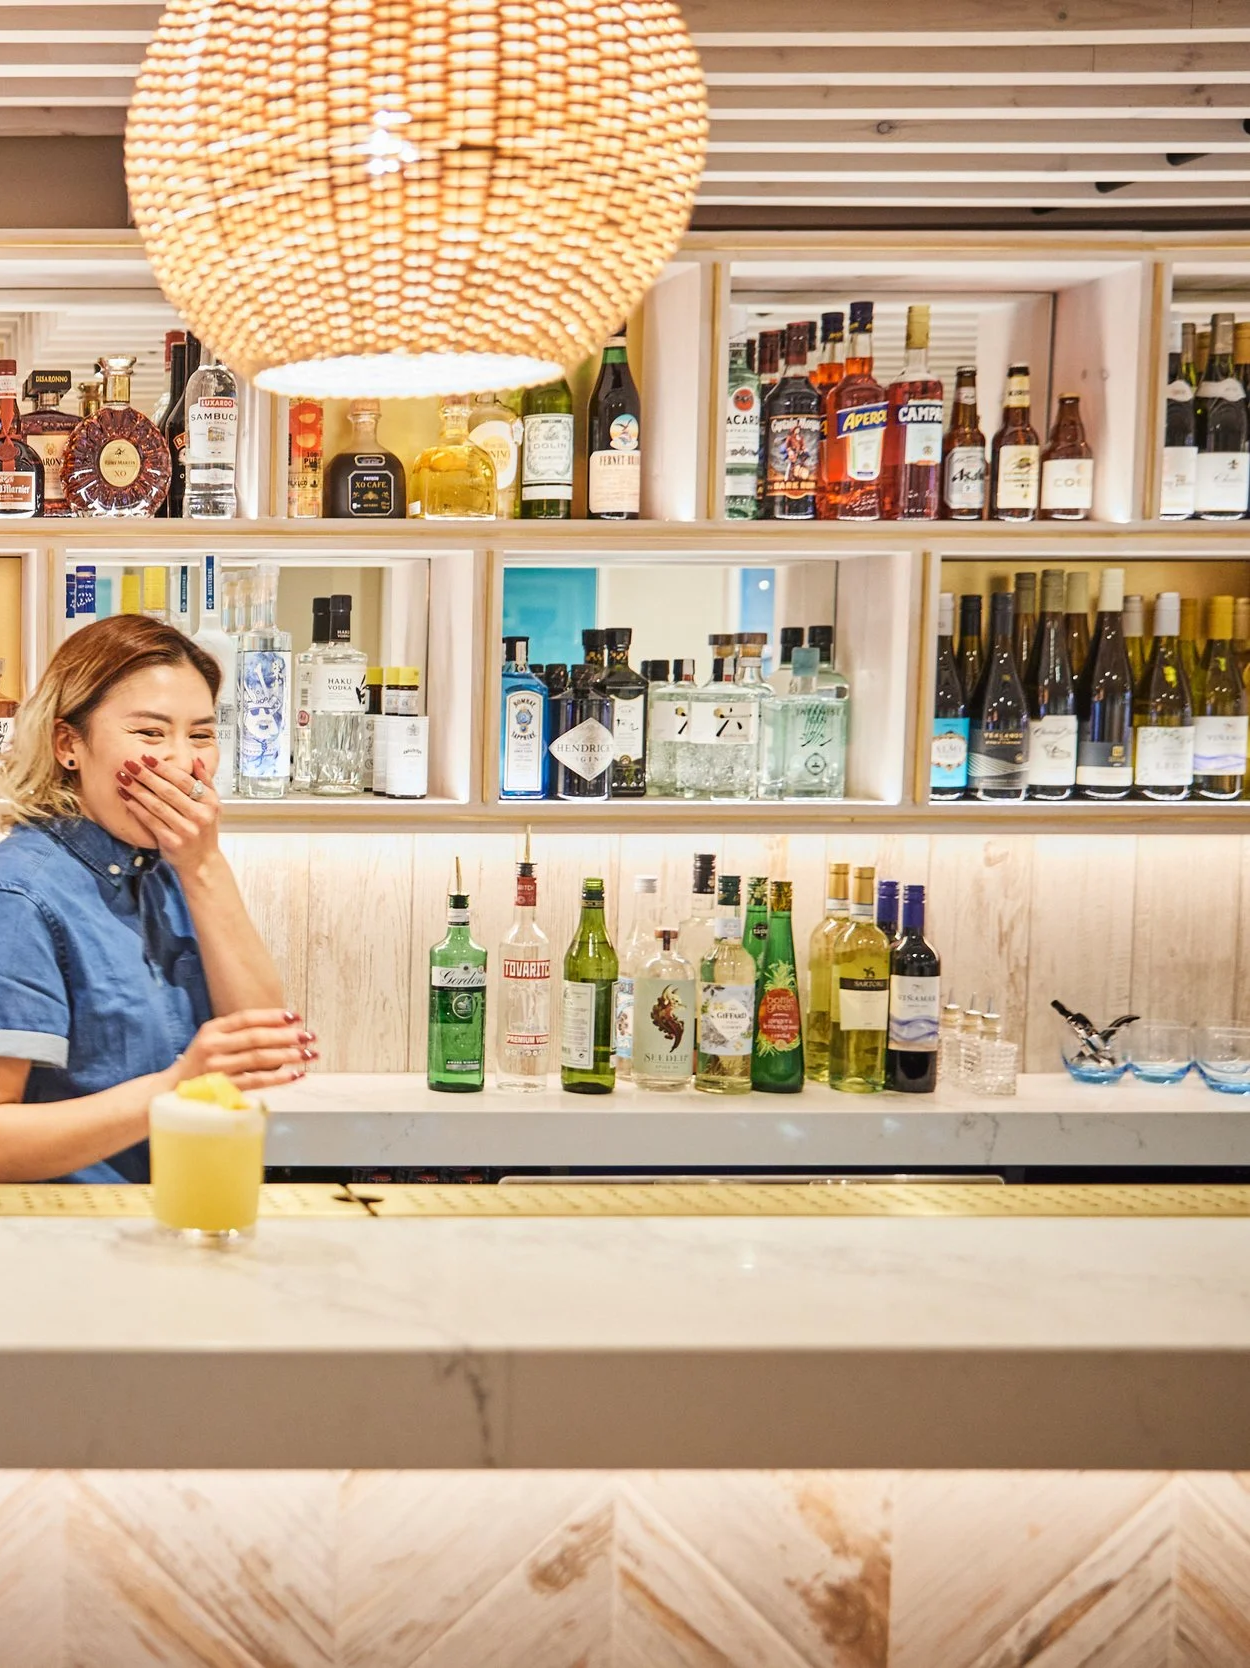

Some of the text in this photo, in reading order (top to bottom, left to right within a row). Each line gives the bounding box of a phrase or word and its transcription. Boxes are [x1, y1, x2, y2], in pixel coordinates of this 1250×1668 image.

[35, 375, 68, 383] DISARONNO
[114, 470, 127, 478] XO
[513, 698, 536, 708] BOMBAY
[511, 732, 536, 741] SAPPHIRE
[504, 961, 550, 977] TOVARITC
[767, 995, 795, 1004] bottle
[768, 1003, 795, 1012] green
[507, 1036, 536, 1044] PREMIUM
[644, 1053, 689, 1062] SEEDLIP
